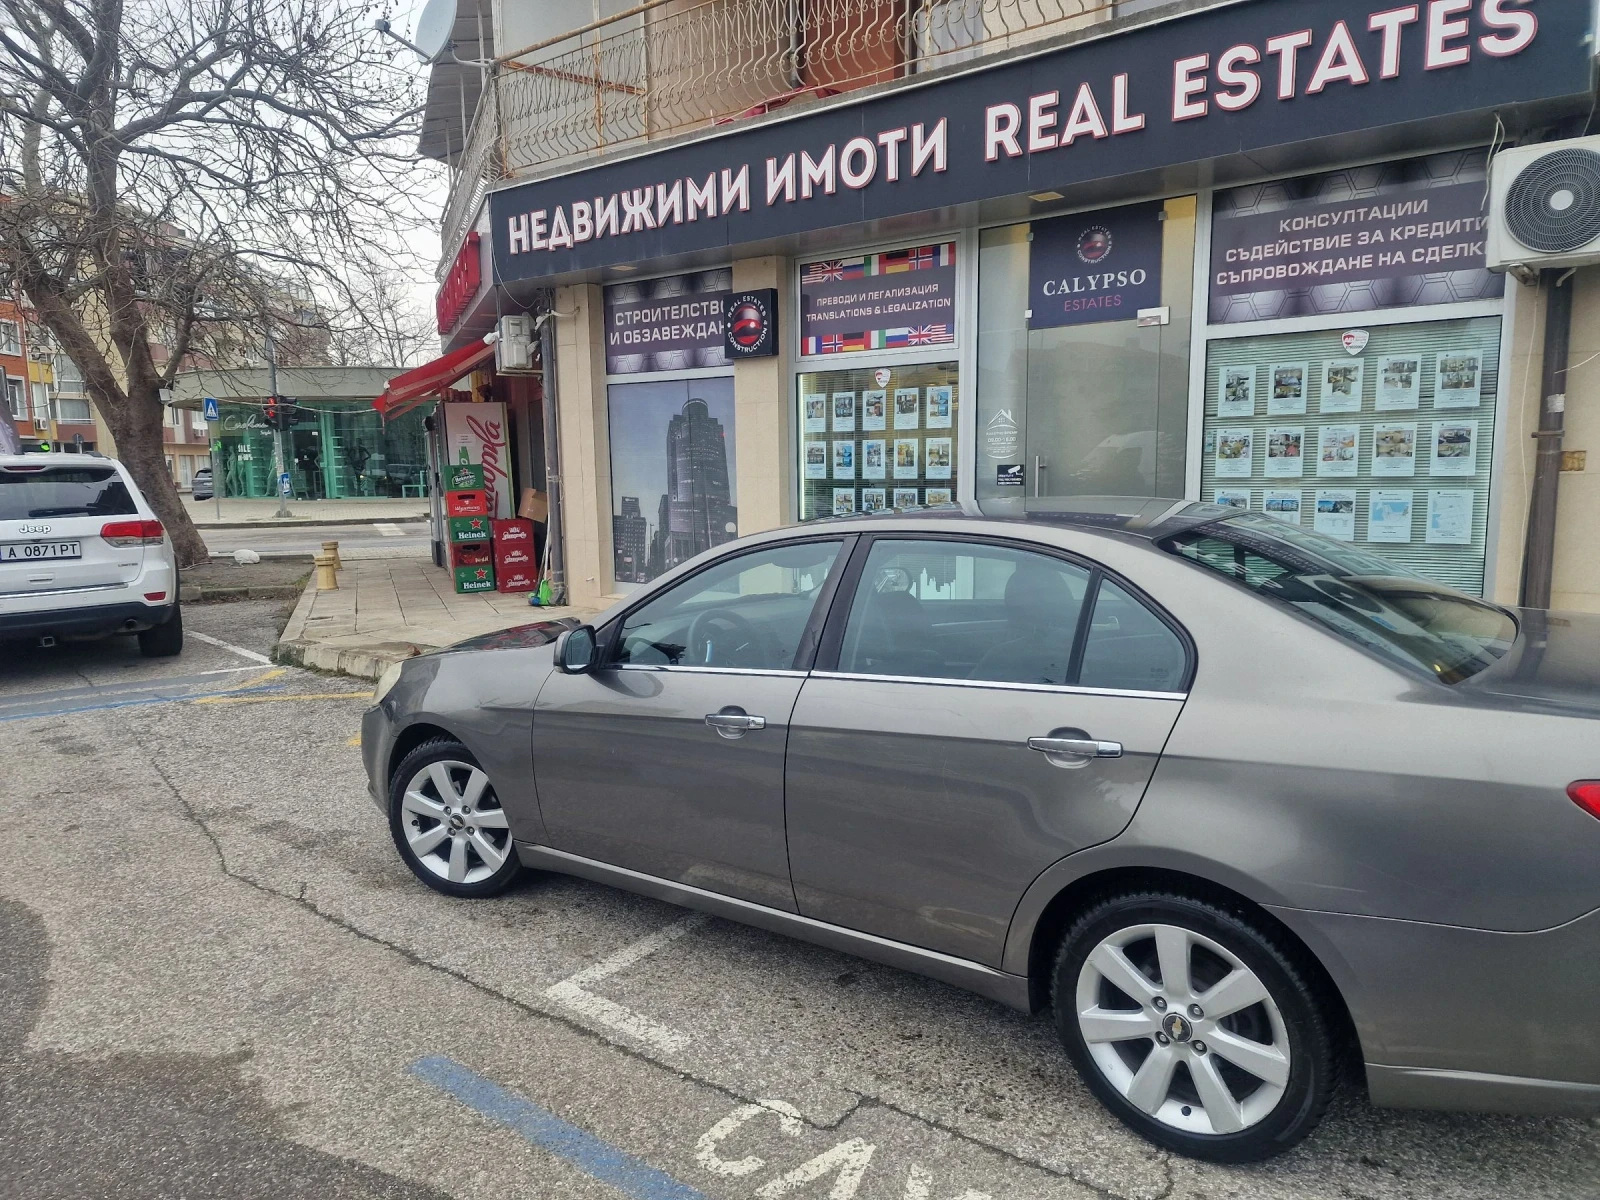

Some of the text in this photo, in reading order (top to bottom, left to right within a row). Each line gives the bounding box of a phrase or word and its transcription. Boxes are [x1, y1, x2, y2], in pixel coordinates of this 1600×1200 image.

[984, 0, 1539, 162] REAL ESTATES
[508, 116, 948, 255] НЕДВИЖИМИ ИМОТИ
[1279, 199, 1429, 233] КОНСУЛТАЦИИ
[1225, 233, 1352, 263] СЪДЕЙСТВИЕ
[1357, 231, 1385, 246] ЗА
[1216, 241, 1487, 286] СЪПРОВОЖДАНЕ НА СДЕЛК
[1043, 268, 1147, 296] CALYPSO
[742, 295, 767, 317] ESTATES
[816, 283, 939, 307] ПРЕВОДИ И ЛЕГАЛИЗАЦИЯ
[1064, 294, 1122, 312] ESTATES
[615, 300, 724, 326] СТРОИТЕЛСТВ
[728, 300, 741, 317] REAL
[806, 297, 951, 322] TRANSLATIONS & LEGALIZATION
[610, 333, 620, 346] И
[728, 327, 768, 352] CONSTRUCTION
[19, 524, 51, 535] Jeep
[458, 530, 486, 539] Heinek
[8, 543, 77, 558] A 0871 PT
[463, 580, 491, 590] Heinek
